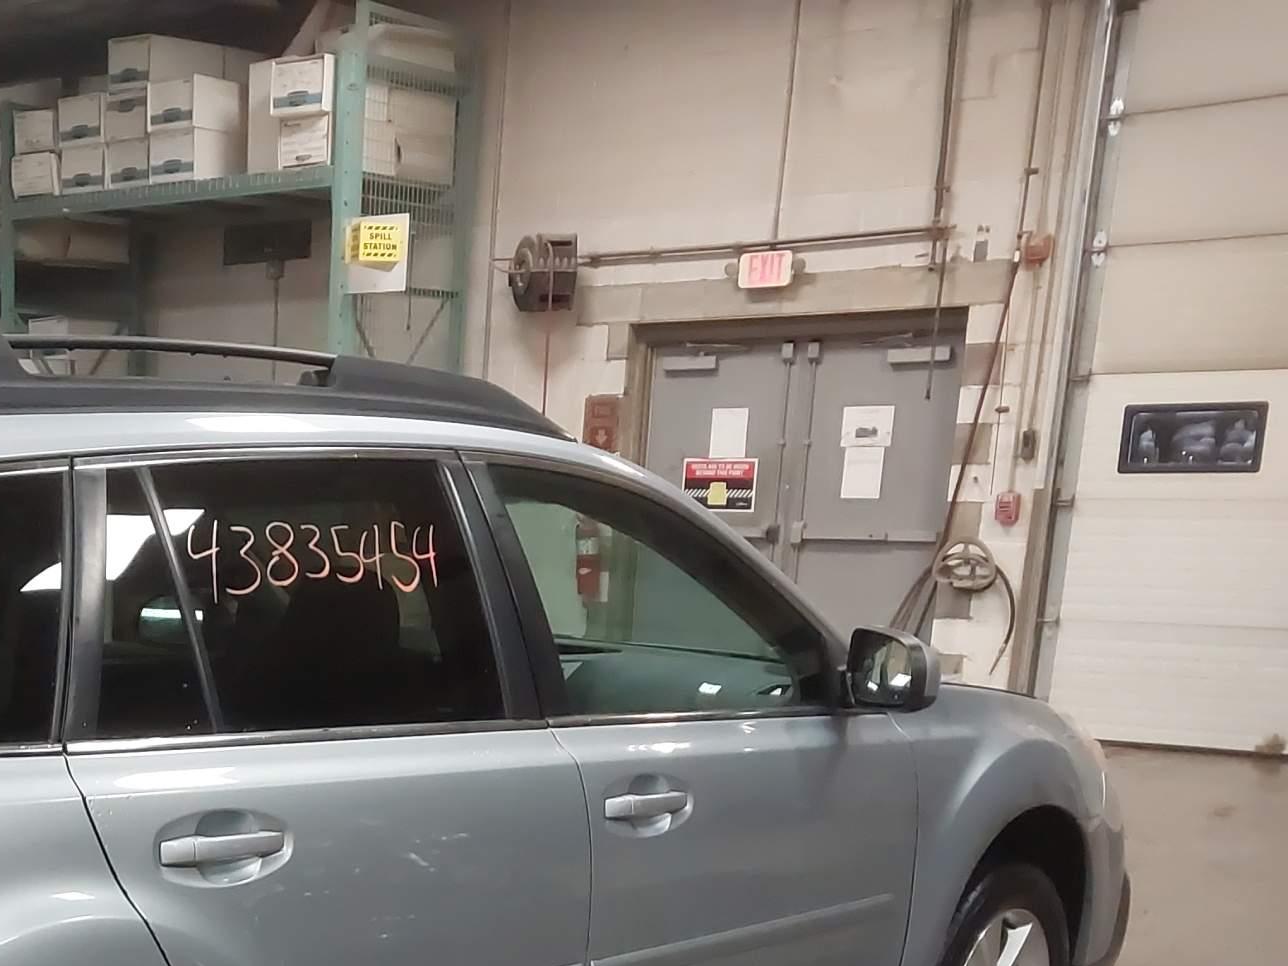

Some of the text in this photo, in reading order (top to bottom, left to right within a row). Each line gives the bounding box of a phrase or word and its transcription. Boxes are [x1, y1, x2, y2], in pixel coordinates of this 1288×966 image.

[369, 232, 392, 241] SPILL
[363, 242, 397, 251] STATION
[748, 253, 786, 283] EXIT
[187, 519, 438, 605] 43835454
